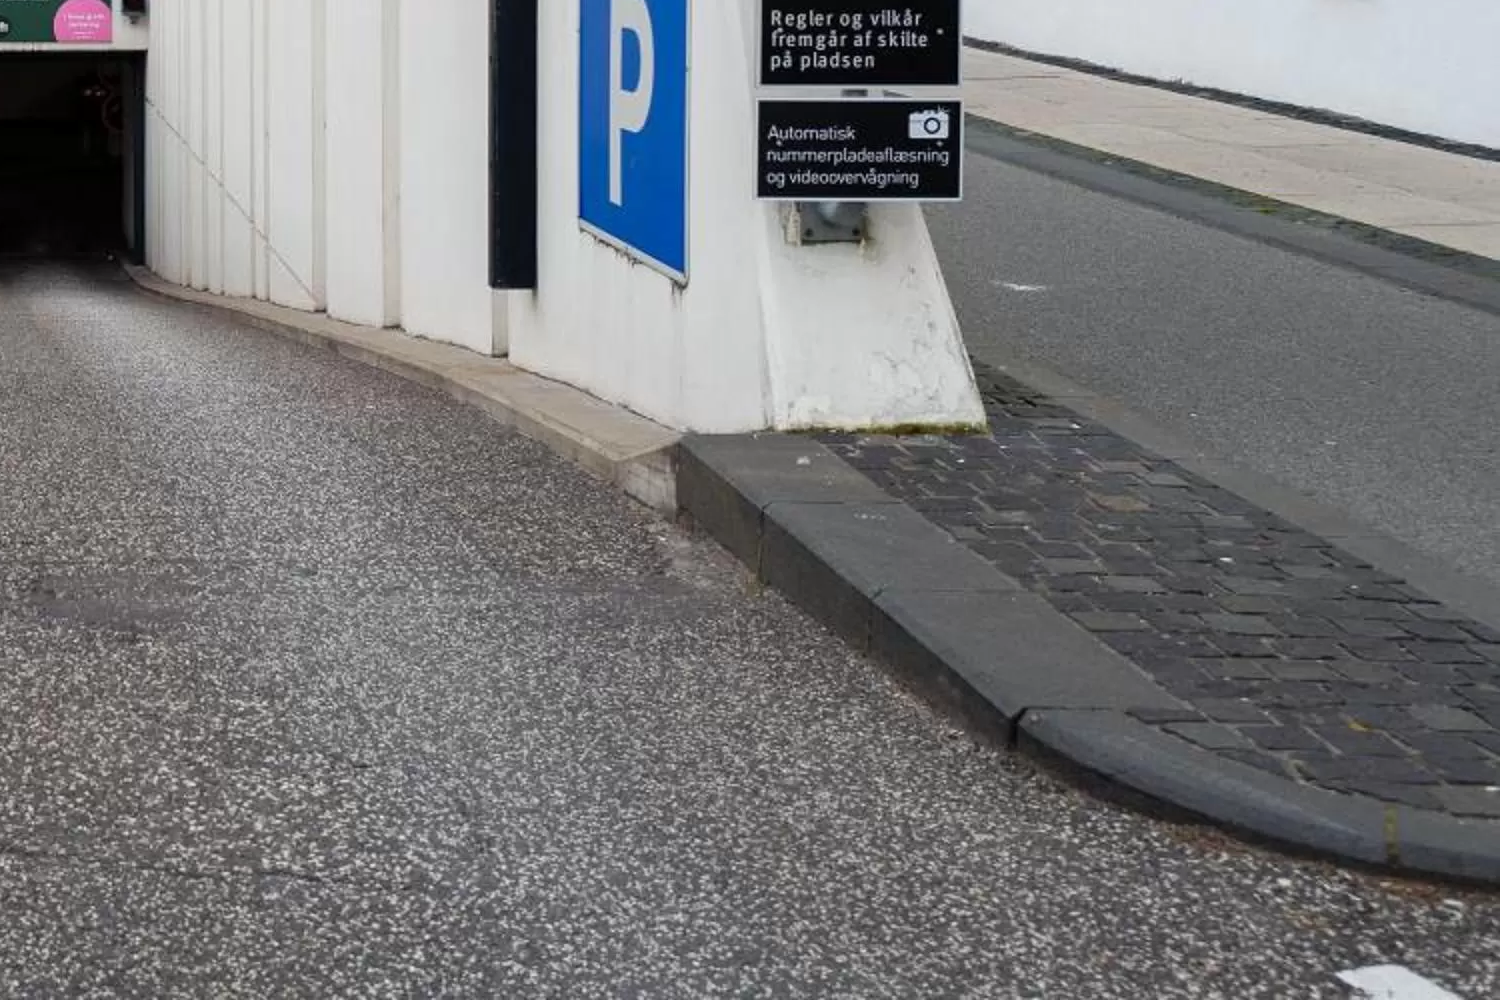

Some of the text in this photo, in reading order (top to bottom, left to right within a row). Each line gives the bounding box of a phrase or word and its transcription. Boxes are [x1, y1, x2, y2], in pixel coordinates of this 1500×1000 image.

[770, 9, 922, 29] Regler og vilkår
[771, 30, 928, 50] fremgår af skilte
[770, 50, 875, 71] på pladsen
[767, 125, 855, 141] Automatisk
[767, 148, 949, 166] nummerpladeaflæsning
[767, 168, 919, 189] og videoovervågning
